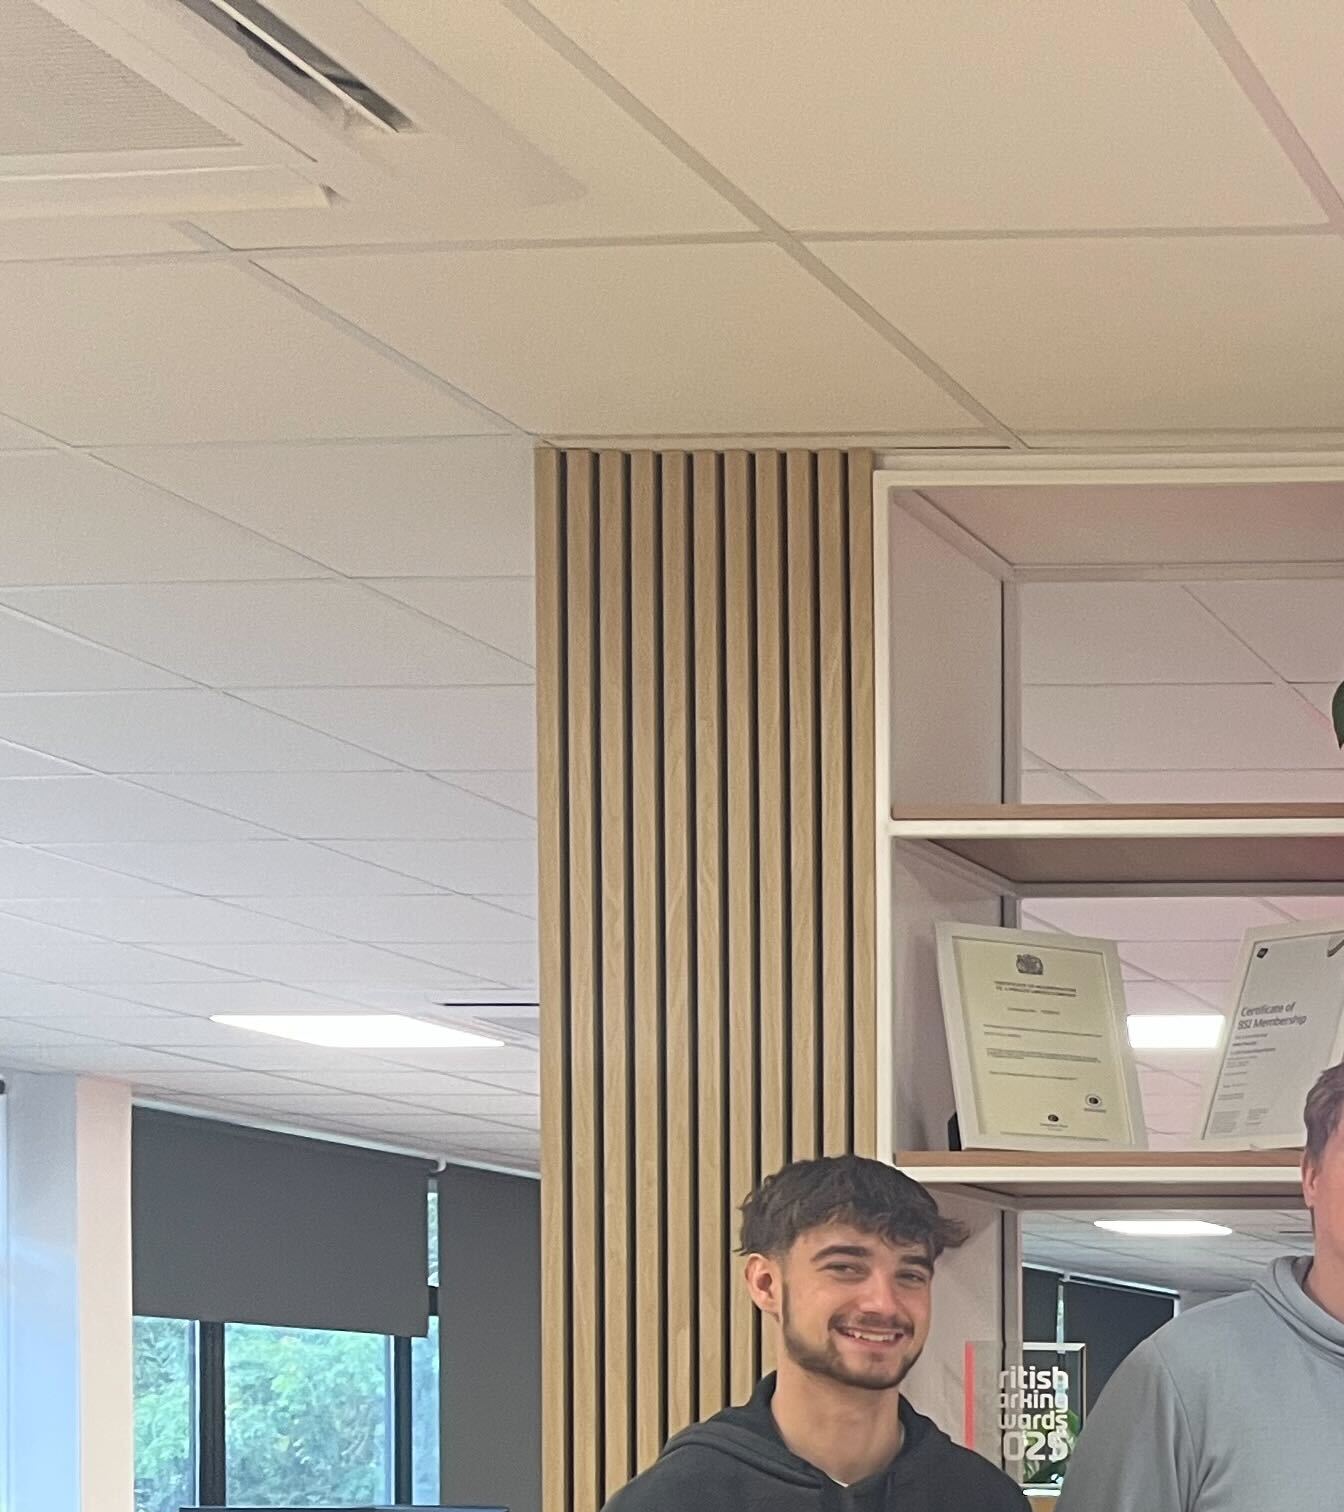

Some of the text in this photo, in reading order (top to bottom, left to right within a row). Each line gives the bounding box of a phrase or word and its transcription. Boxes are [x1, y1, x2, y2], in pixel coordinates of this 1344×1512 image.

[1241, 1001, 1296, 1017] Certificate of
[1253, 1016, 1307, 1029] Membership
[998, 1365, 1069, 1389] ritish
[998, 1389, 1069, 1413] arking
[998, 1410, 1068, 1430] wards
[1003, 1430, 1069, 1462] 025
